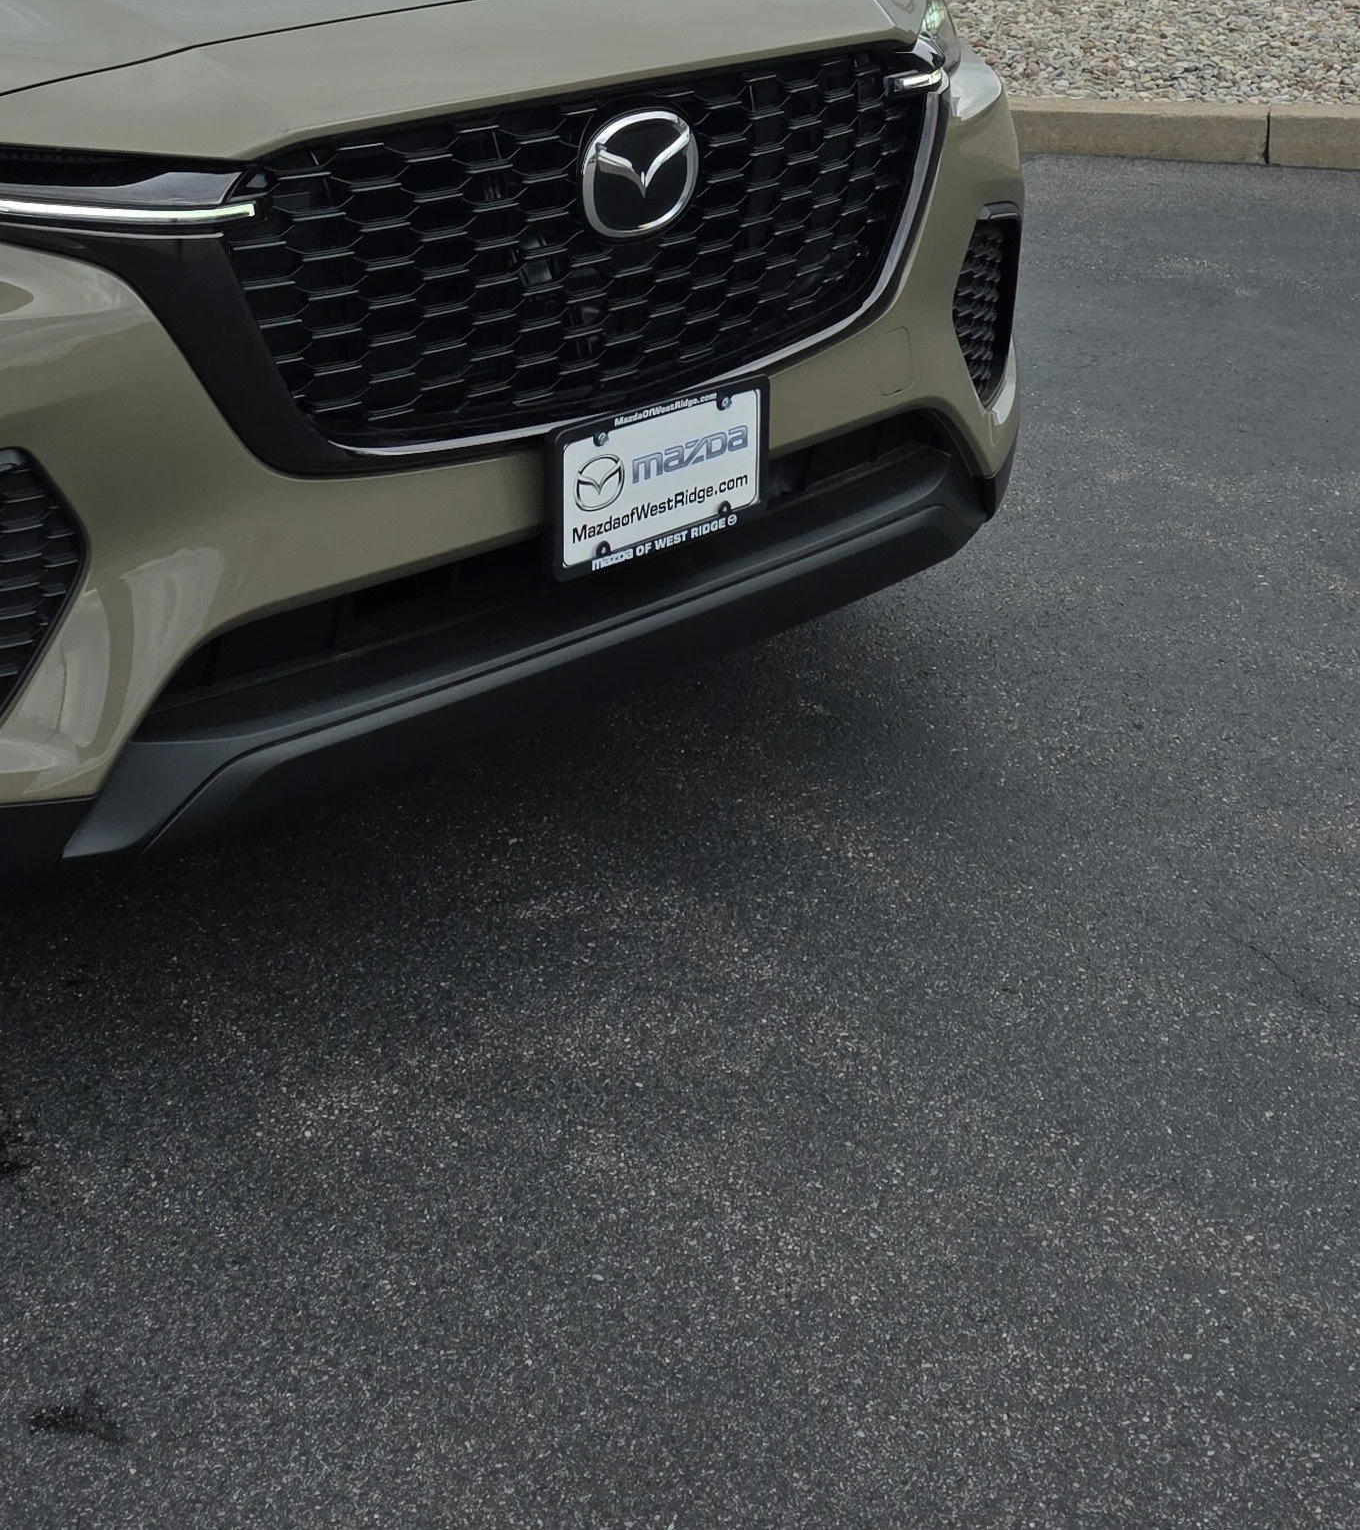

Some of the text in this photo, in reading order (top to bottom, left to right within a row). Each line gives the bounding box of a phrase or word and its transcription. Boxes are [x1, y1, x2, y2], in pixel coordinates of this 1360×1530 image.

[632, 425, 749, 484] mazda
[572, 473, 749, 544] MazdaofWestRidge.com
[635, 541, 653, 557] OF
[654, 530, 688, 551] WEST
[690, 517, 727, 539] RIDGE
